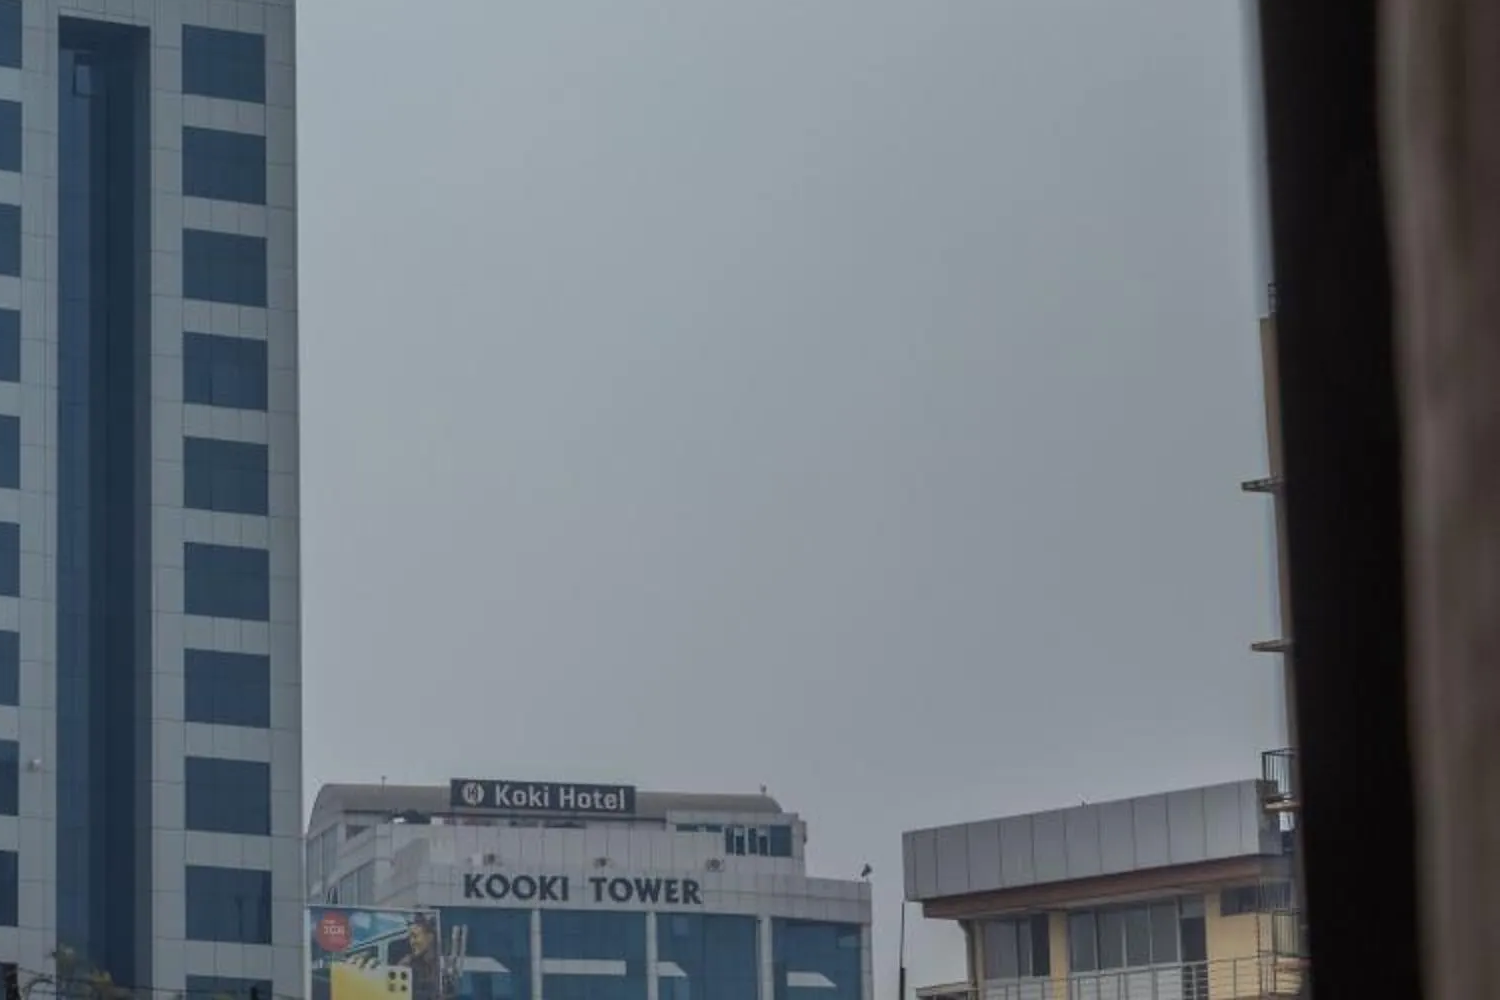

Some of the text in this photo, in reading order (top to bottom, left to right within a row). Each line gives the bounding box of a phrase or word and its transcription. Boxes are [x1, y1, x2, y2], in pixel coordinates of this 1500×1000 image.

[495, 784, 549, 806] Koki
[560, 787, 626, 810] Hotel
[464, 873, 702, 904] KOOKI TOWER
